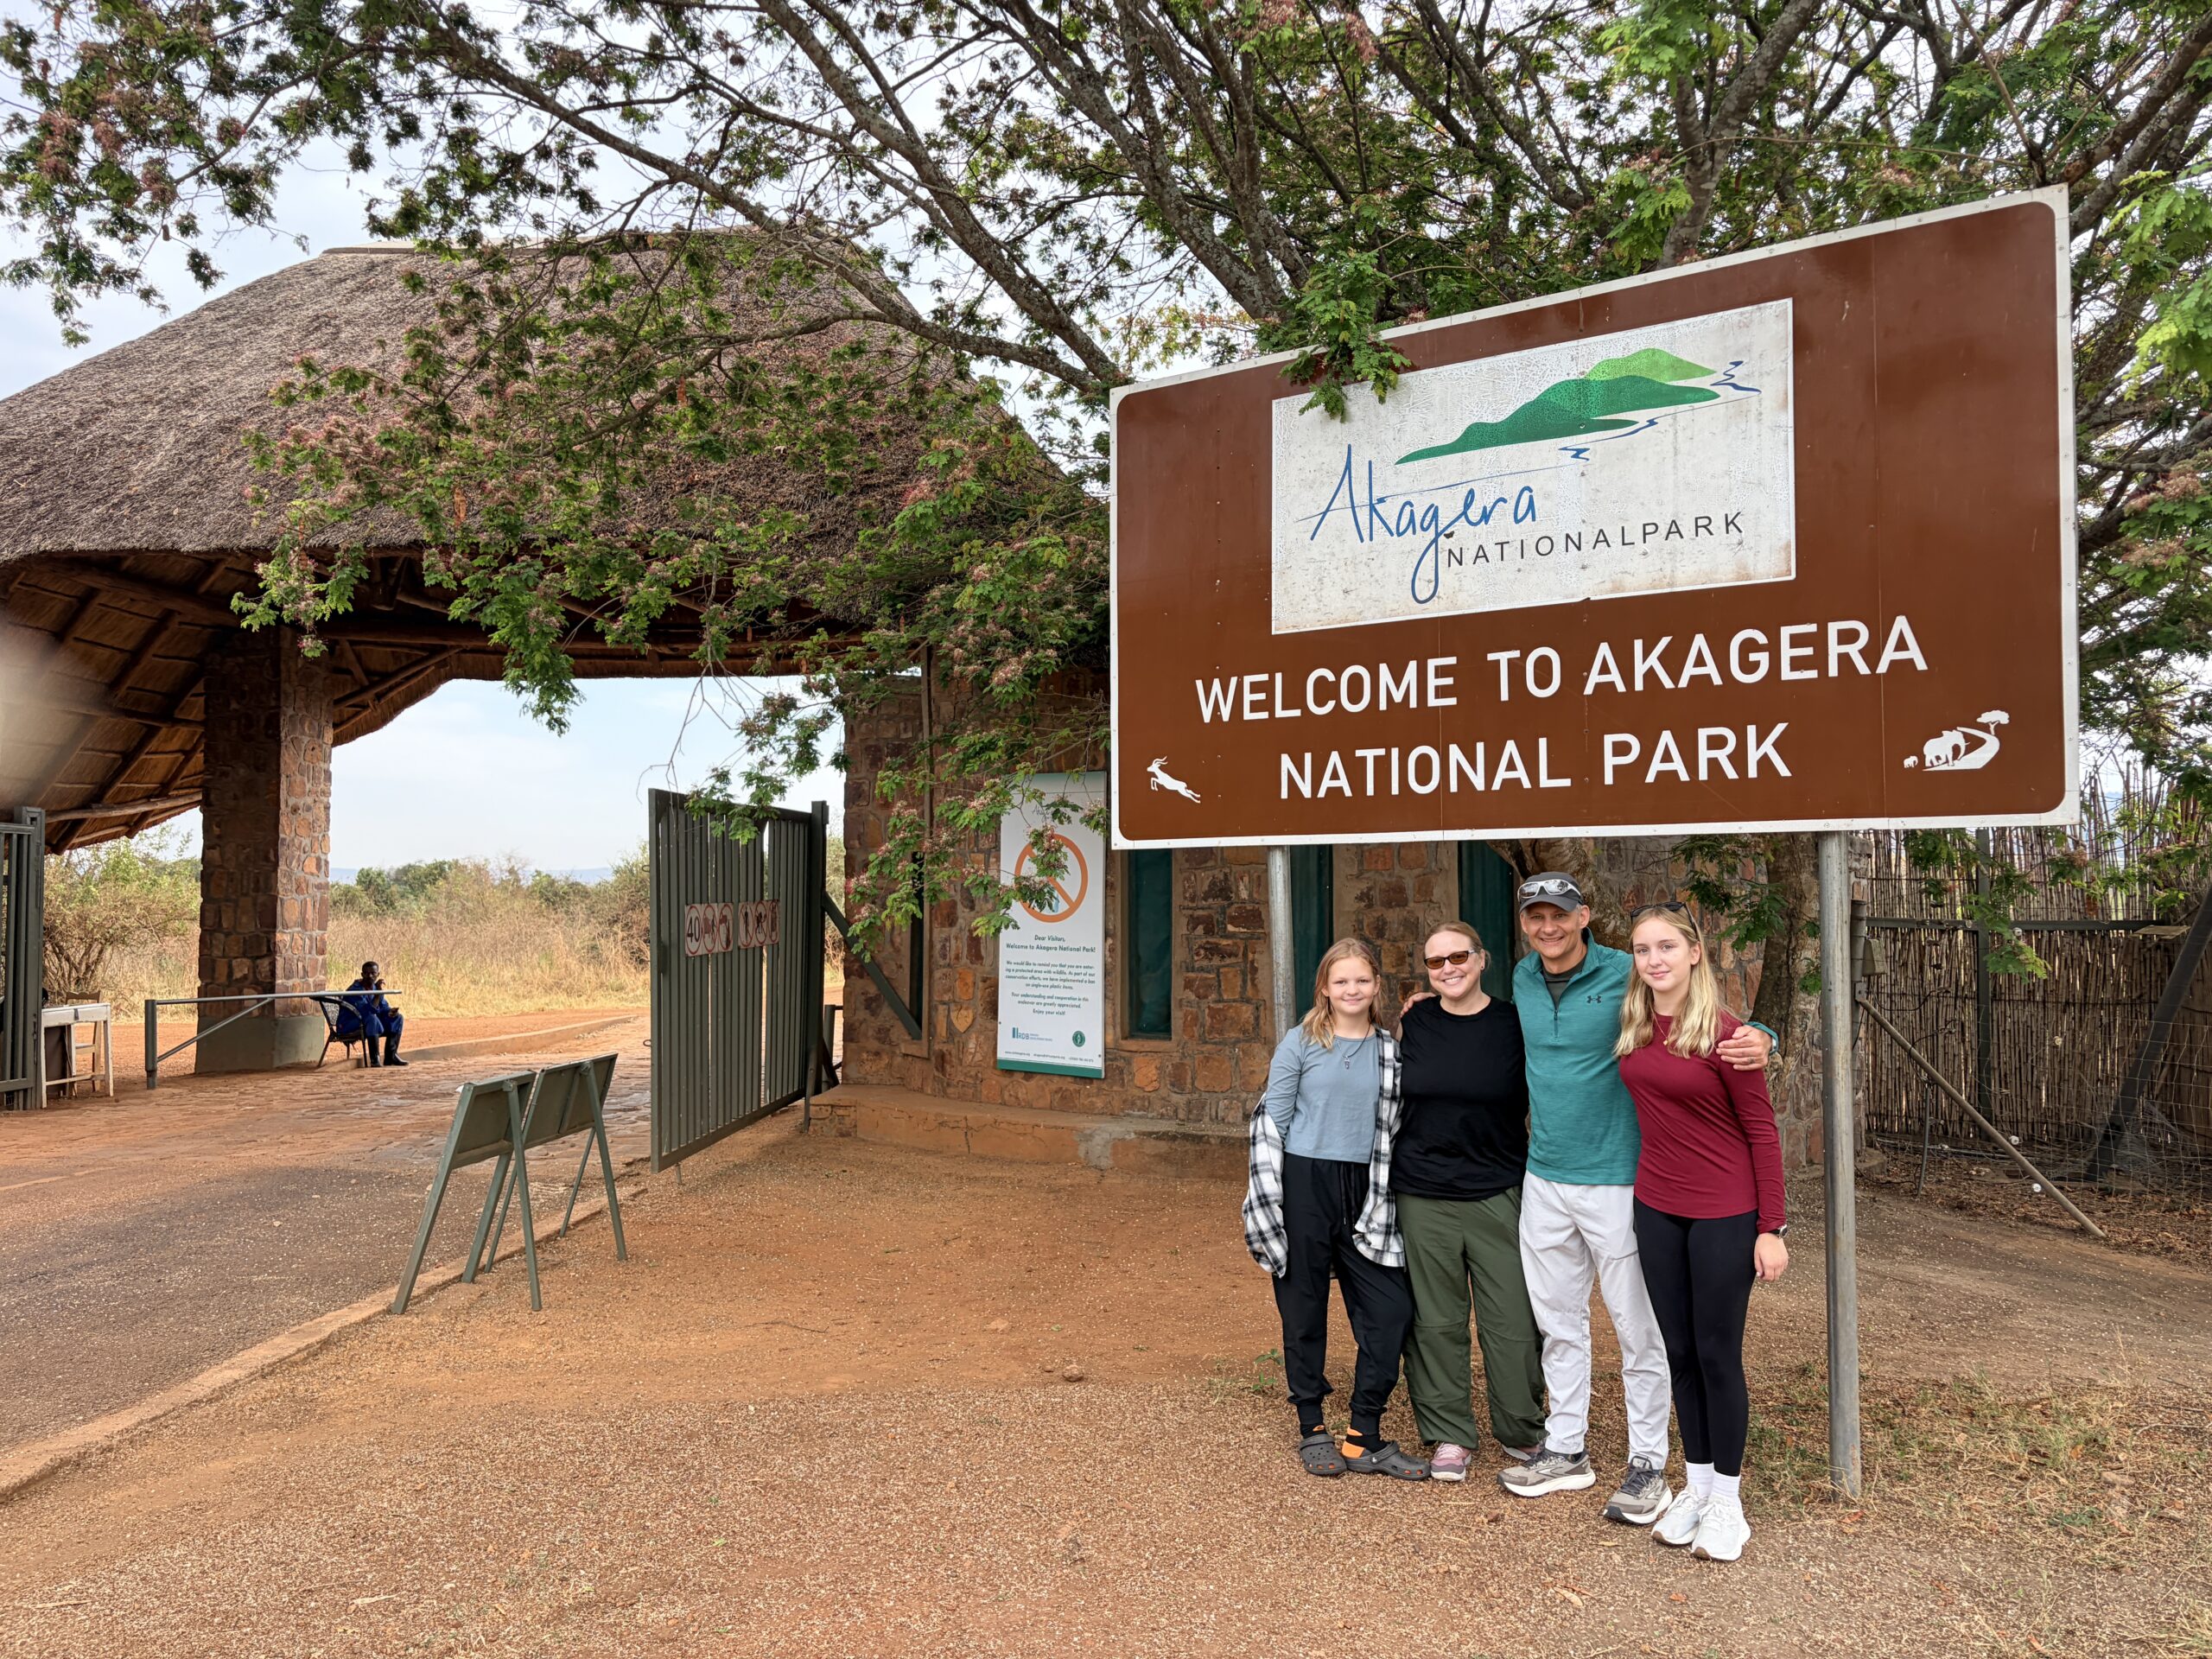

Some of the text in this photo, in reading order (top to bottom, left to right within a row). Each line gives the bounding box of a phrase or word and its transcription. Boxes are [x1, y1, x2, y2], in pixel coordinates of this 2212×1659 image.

[1310, 443, 1536, 604] Akagera
[1195, 615, 1929, 723] WELCOME TO AKAGERA
[1281, 722, 1792, 799] NATIONAL PARK
[687, 916, 700, 943] 40
[1018, 1032, 1029, 1040] RDB
